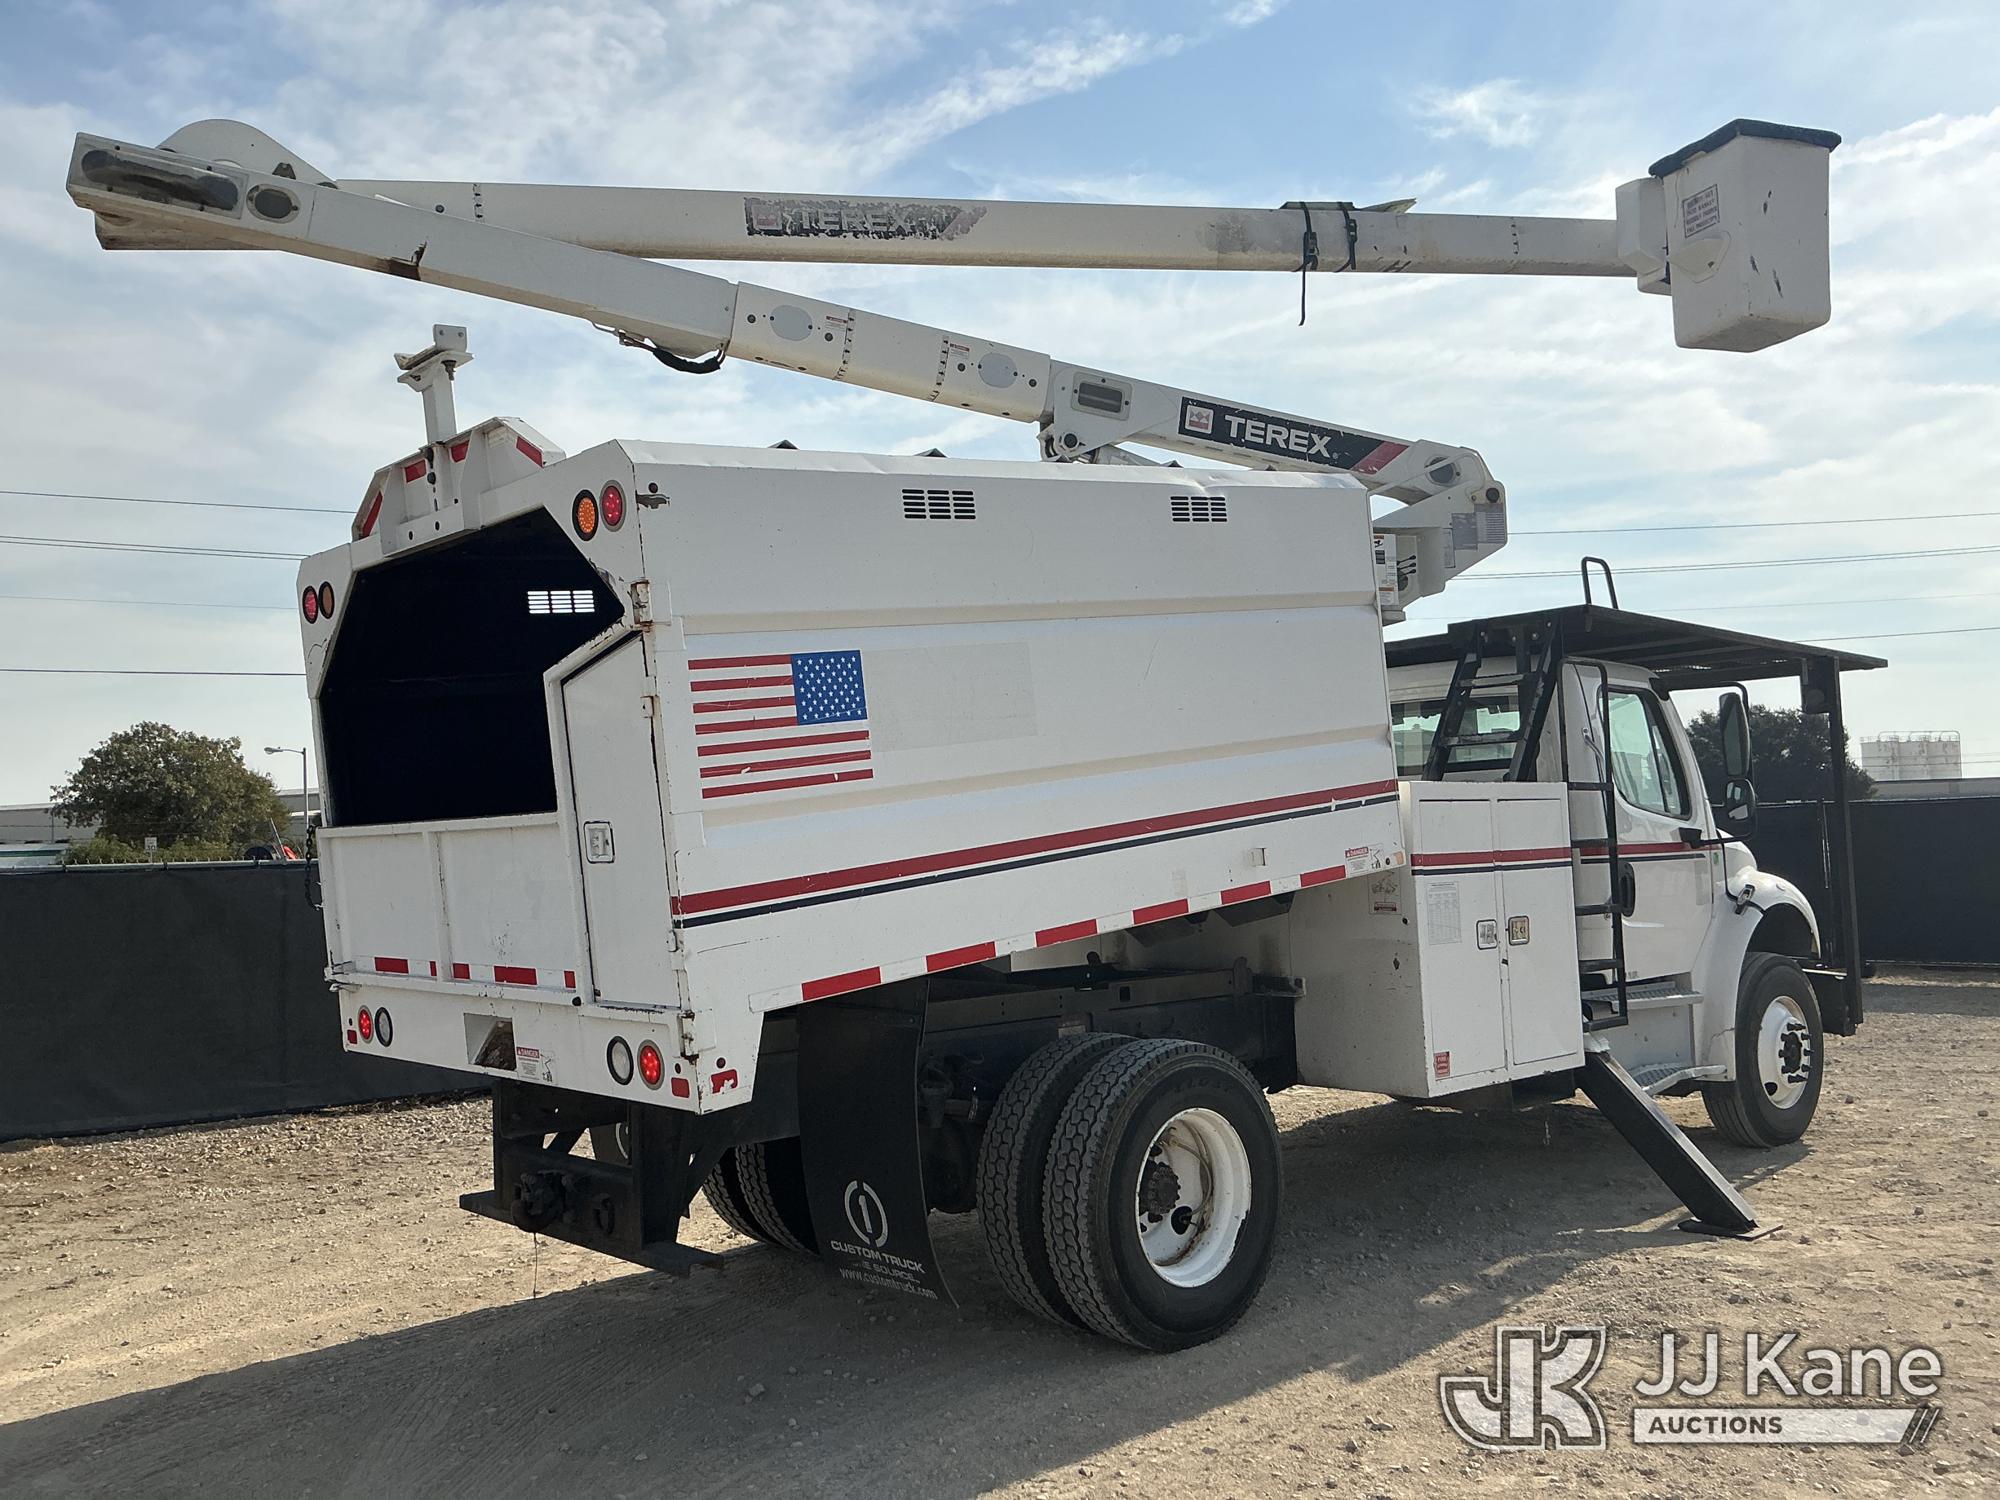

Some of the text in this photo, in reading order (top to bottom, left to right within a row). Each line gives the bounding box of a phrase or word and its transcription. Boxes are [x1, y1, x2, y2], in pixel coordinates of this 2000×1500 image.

[796, 207, 908, 233] TEREX
[1224, 414, 1332, 458] TEREX
[830, 1240, 882, 1261] CUSTOM
[882, 1253, 926, 1274] TRUCK
